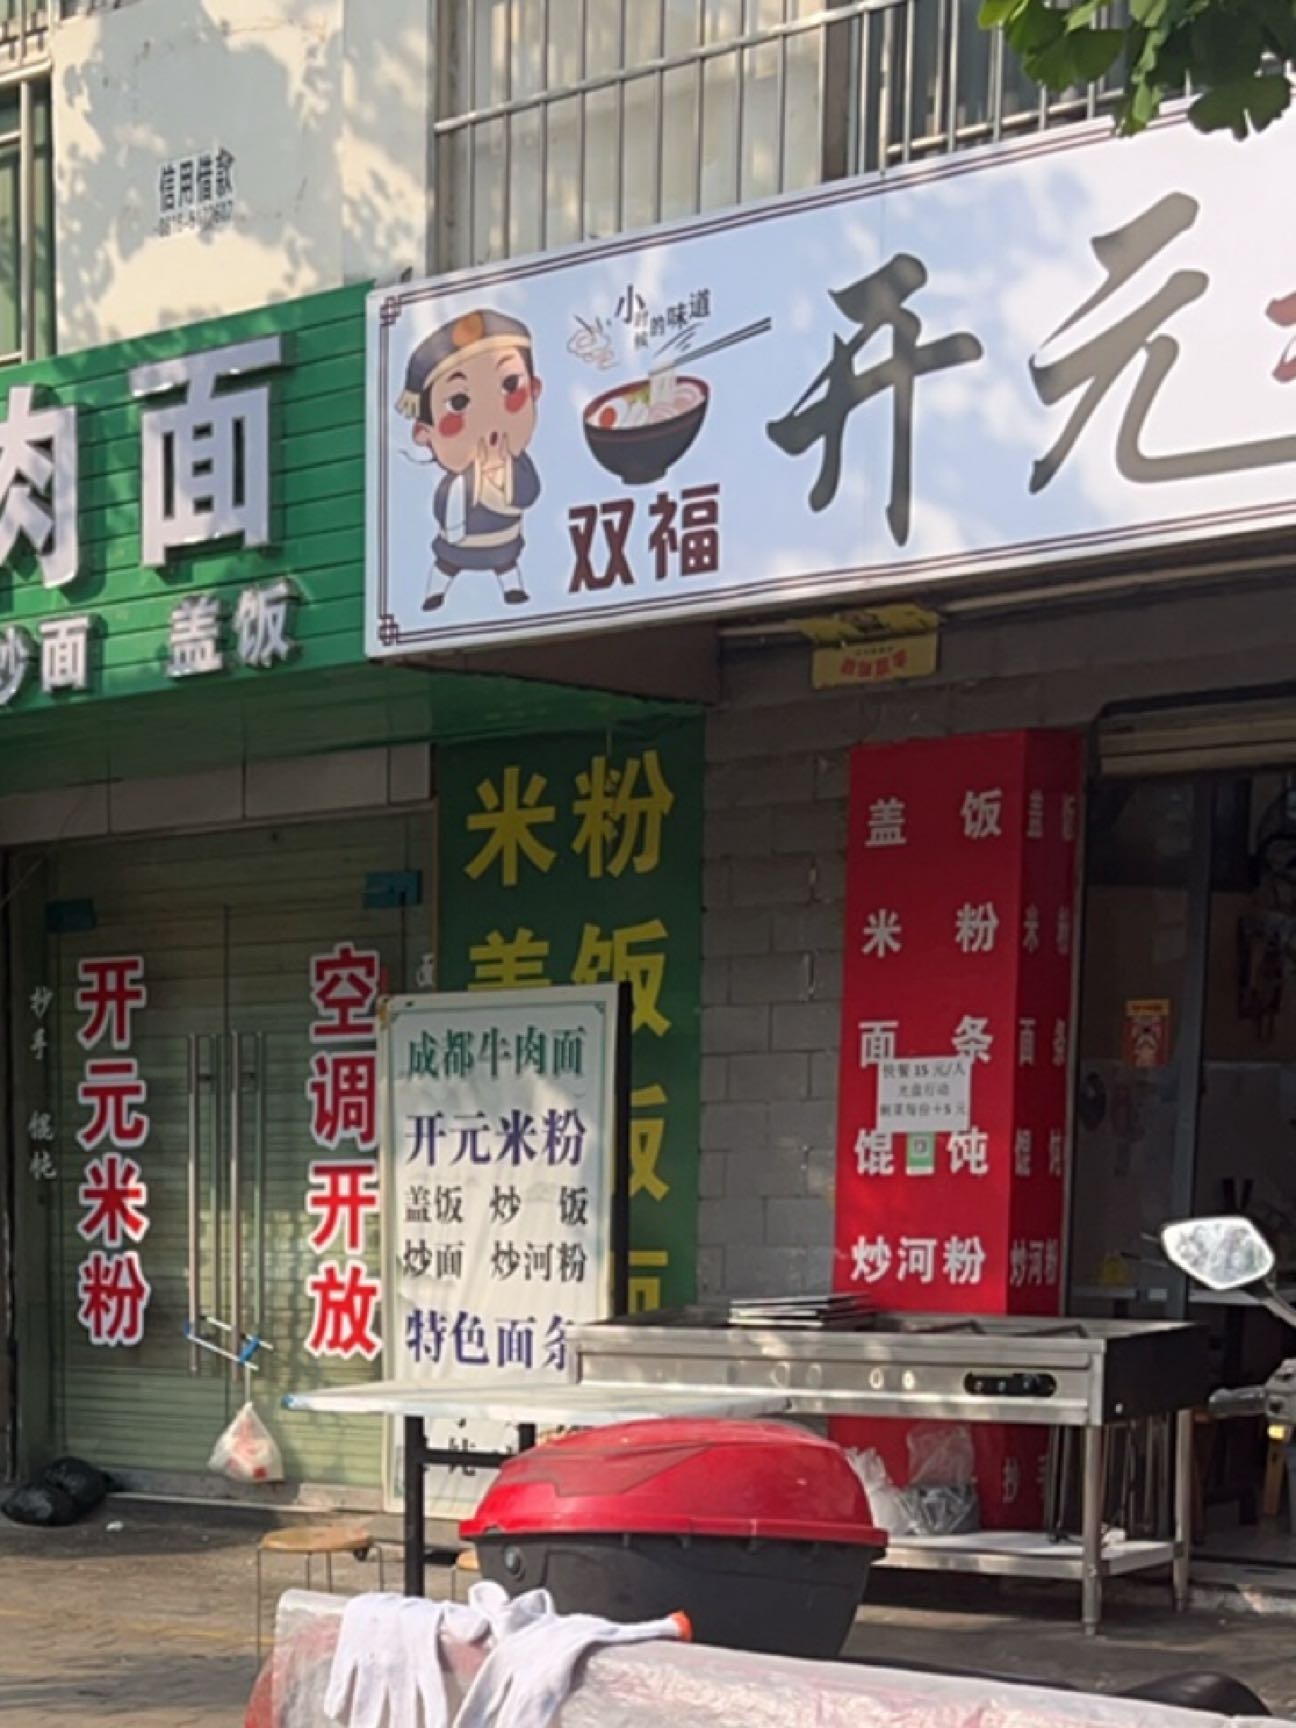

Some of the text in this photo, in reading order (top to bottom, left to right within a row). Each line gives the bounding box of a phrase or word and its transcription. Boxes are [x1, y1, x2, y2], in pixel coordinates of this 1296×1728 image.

[766, 190, 1296, 546] 开元
[567, 483, 721, 593] 双福
[167, 579, 292, 677] 盖饭
[464, 750, 674, 886] 米粉
[865, 788, 1003, 847] 盖饭
[862, 902, 1000, 958] 米粉
[408, 1025, 586, 1080] 成都牛肉面
[858, 1015, 994, 1068] 面条
[78, 956, 149, 1345] 开元米粉
[306, 942, 382, 1357] 空调开放
[406, 1109, 587, 1167] 开元米粉
[854, 1126, 989, 1176] 馄饨
[404, 1185, 464, 1225] 盖饭
[404, 1239, 465, 1277] 炒面
[491, 1240, 587, 1283] 炒河粉
[851, 1236, 986, 1284] 炒河粉
